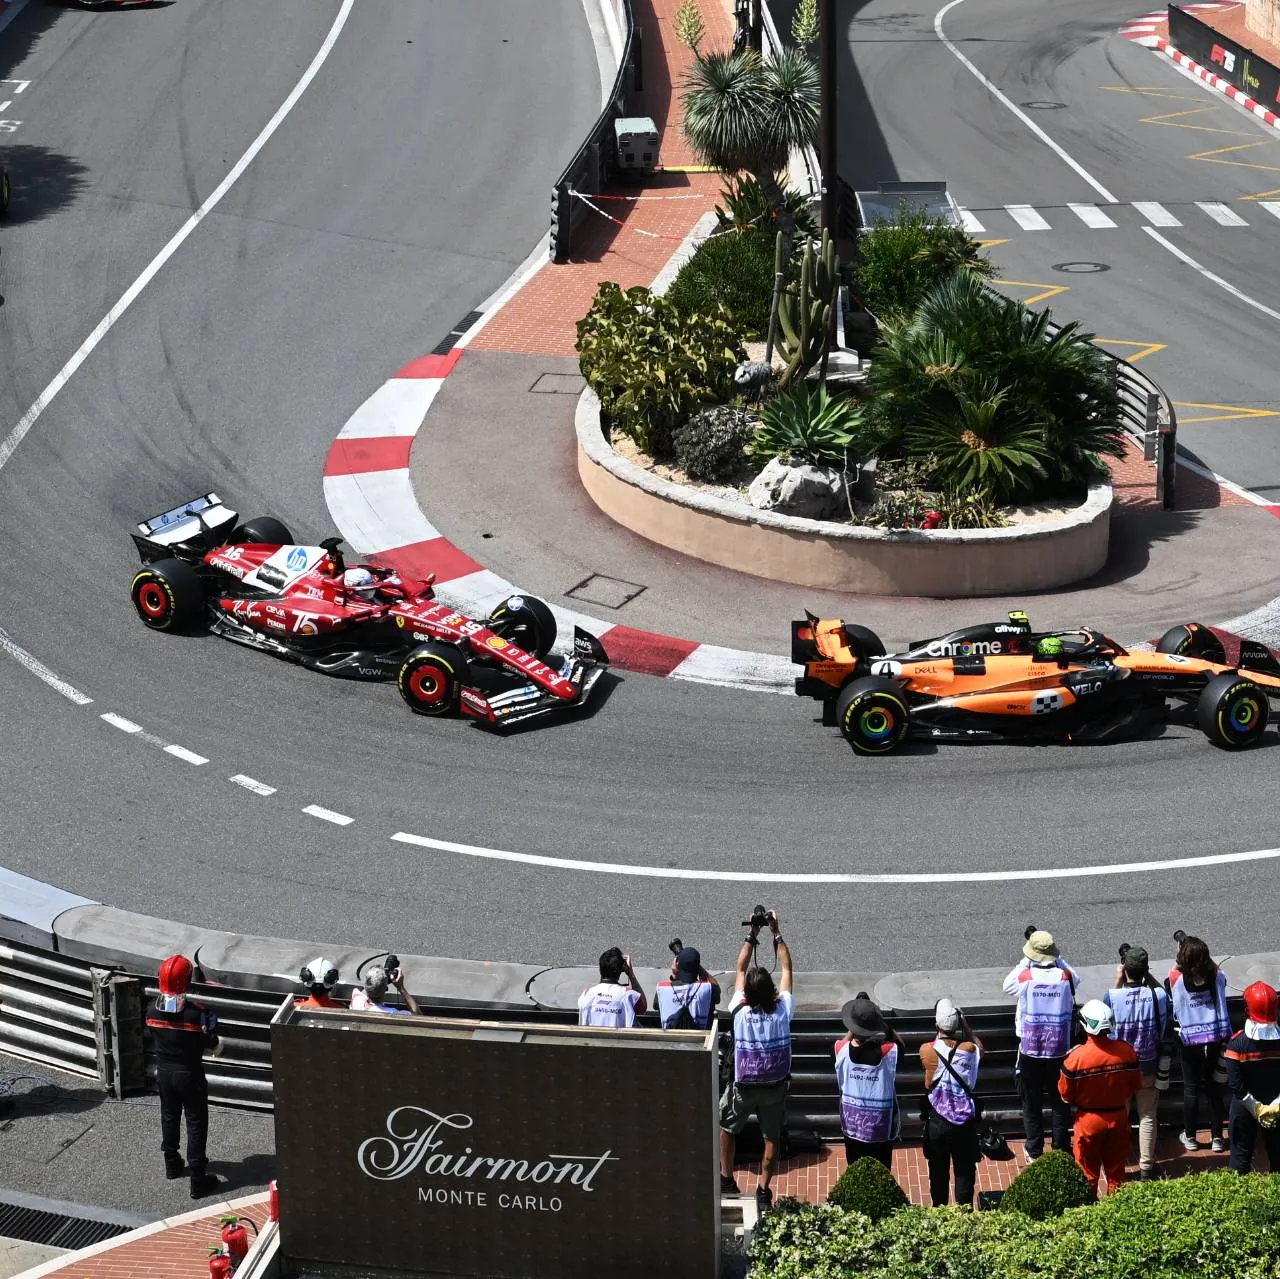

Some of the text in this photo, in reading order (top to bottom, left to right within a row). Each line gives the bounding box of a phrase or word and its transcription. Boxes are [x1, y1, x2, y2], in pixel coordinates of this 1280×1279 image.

[220, 546, 245, 560] 16
[287, 548, 307, 571] hp
[995, 625, 1027, 634] allwyn
[575, 638, 592, 650] aws
[359, 667, 382, 675] VGW
[879, 663, 894, 679] 4
[1071, 681, 1102, 696] VELO
[357, 1105, 620, 1192] Fairmont
[418, 1187, 562, 1211] MONTE CARLO
